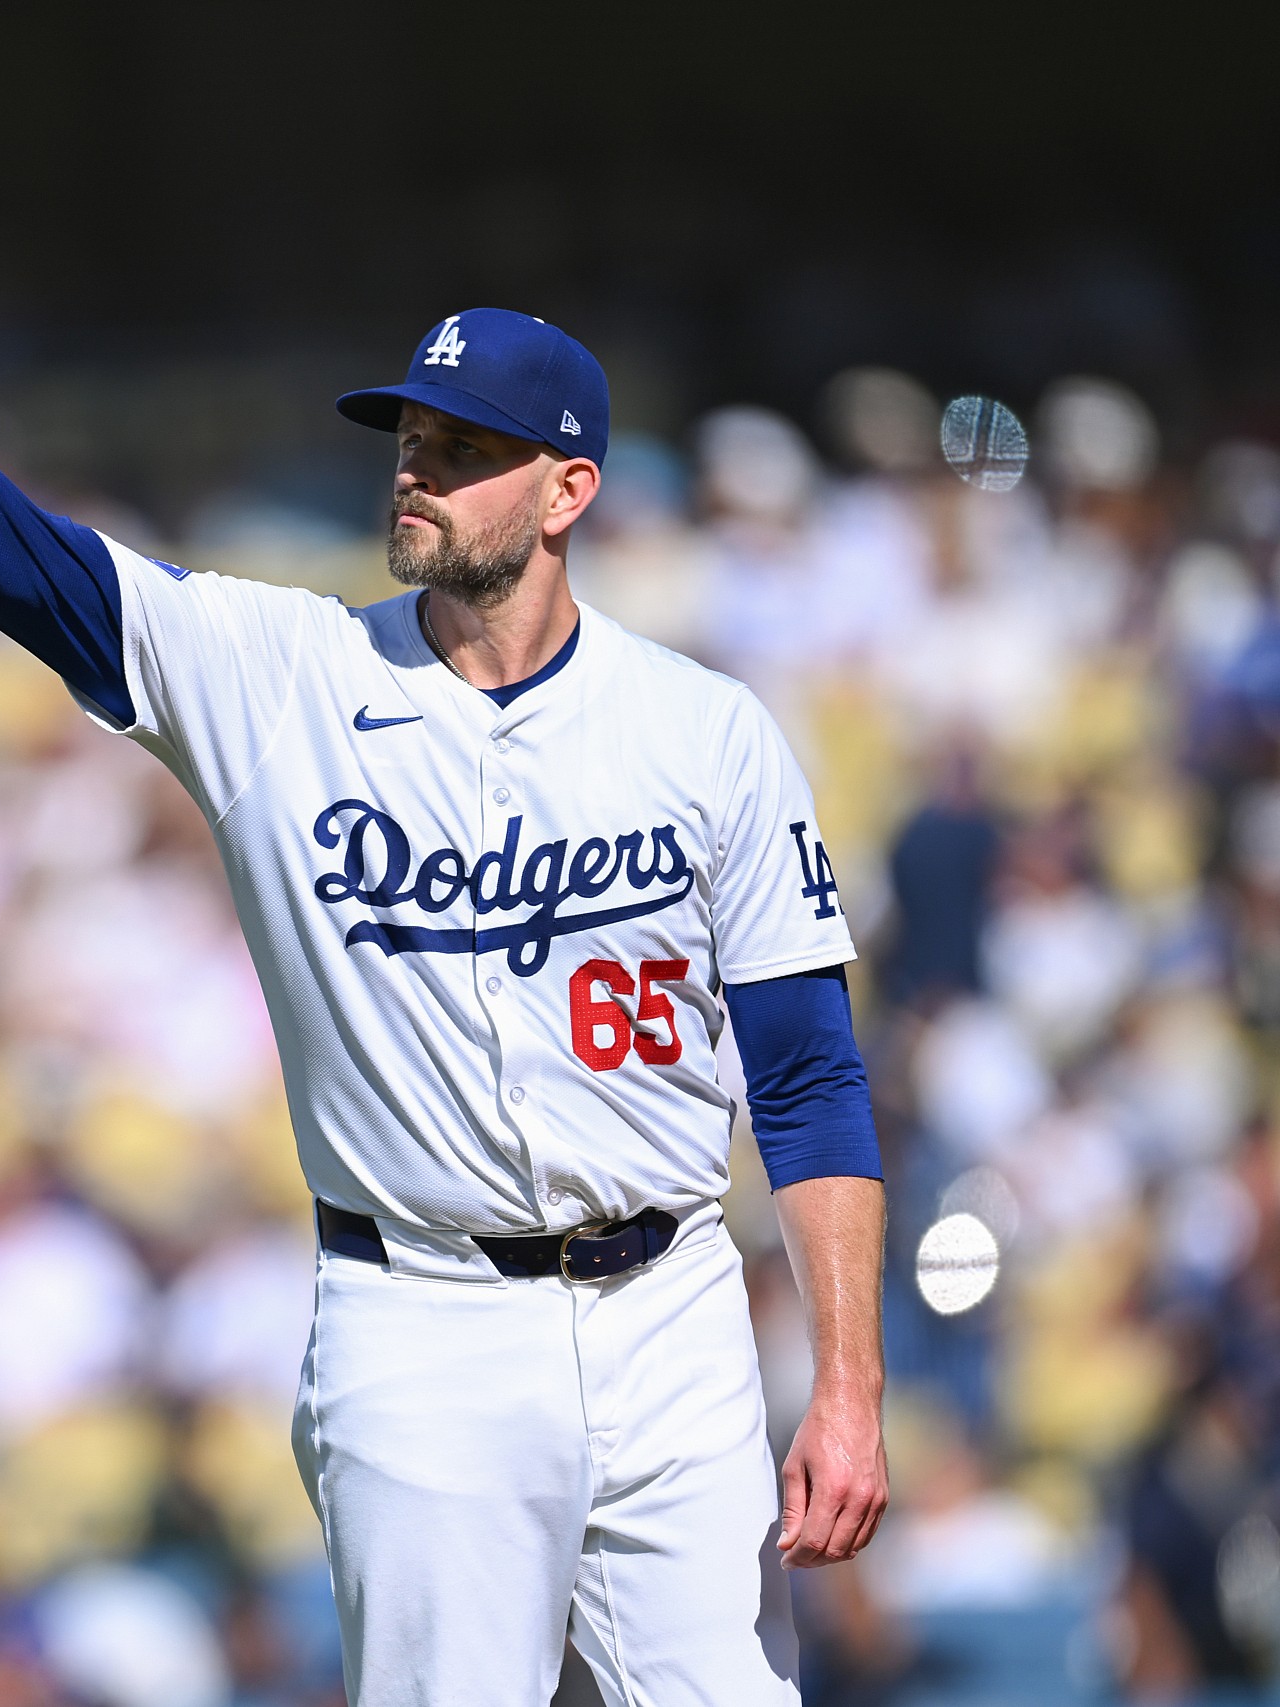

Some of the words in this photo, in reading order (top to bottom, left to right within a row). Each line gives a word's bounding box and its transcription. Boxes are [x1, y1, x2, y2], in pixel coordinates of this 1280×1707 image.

[424, 315, 467, 367] LA
[313, 799, 695, 978] Dodgers
[789, 821, 845, 920] LA
[568, 959, 690, 1071] 65
